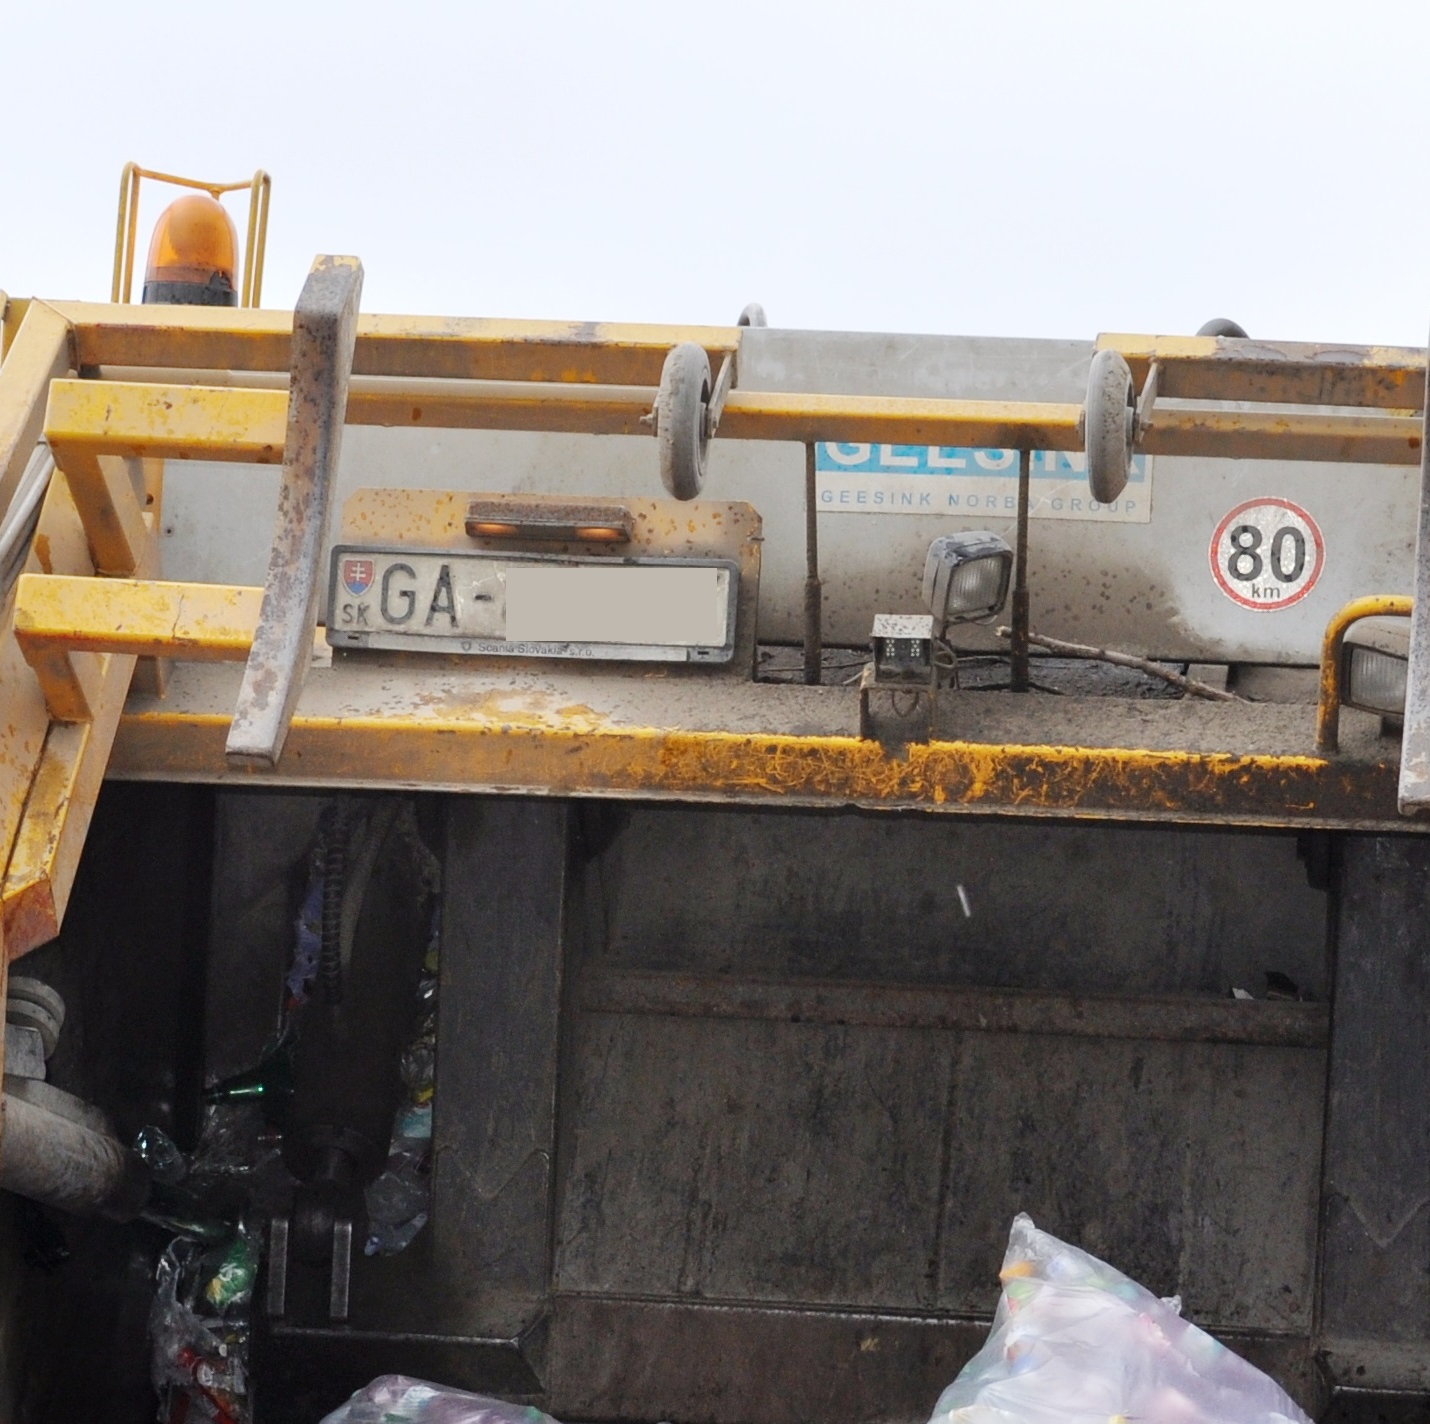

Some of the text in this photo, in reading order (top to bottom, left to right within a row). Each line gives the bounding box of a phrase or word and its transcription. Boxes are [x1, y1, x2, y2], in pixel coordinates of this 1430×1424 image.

[821, 490, 932, 506] GEESINK
[1051, 497, 1137, 513] GROUP
[1228, 525, 1305, 582] 80
[1252, 583, 1280, 598] km
[342, 603, 370, 626] SK
[478, 642, 514, 653] Scania
[517, 643, 563, 655] Slovakia
